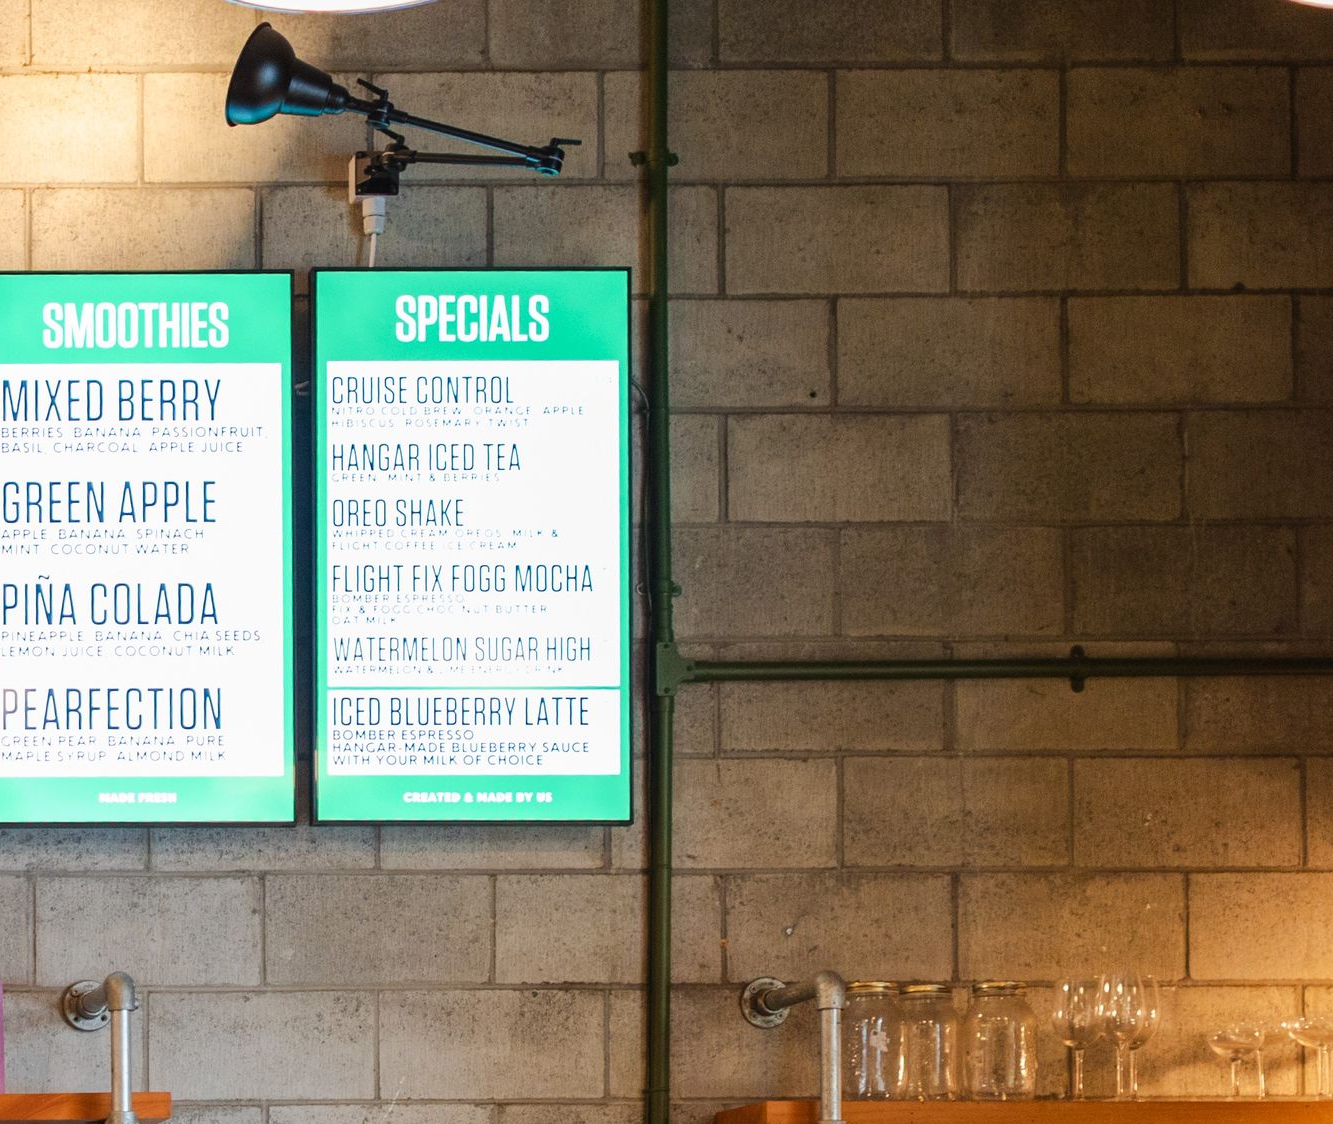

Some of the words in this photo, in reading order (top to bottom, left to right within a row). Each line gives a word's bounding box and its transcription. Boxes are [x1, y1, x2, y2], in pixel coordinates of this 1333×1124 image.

[42, 301, 230, 349] SMOOTHIES
[395, 294, 550, 343] SPECIALS
[2, 378, 104, 422] MIXED
[118, 378, 222, 422] BERRY
[332, 376, 408, 405] CRUISE
[416, 375, 514, 405] CONTROL
[332, 443, 420, 472] HANGAR
[428, 443, 475, 472] ICED
[482, 442, 521, 471] TEA
[2, 480, 105, 524] GREEN
[118, 480, 217, 524] APPLE
[332, 498, 387, 528] OREO
[395, 498, 464, 527] SHAKE
[332, 564, 404, 593] FLIGHT
[412, 564, 443, 593] FIX
[451, 564, 506, 593] FOGG
[514, 564, 594, 593] MOCHA
[2, 574, 77, 626] PIÑA
[90, 581, 219, 626] COLADA
[333, 636, 467, 662] WATERMELON
[475, 636, 539, 662] SUGAR
[546, 636, 591, 662] HIGH
[2, 687, 223, 731] PEARFECTION
[333, 696, 381, 727] ICED
[390, 696, 516, 727] BLUEBERRY
[524, 696, 590, 726] LATTE
[332, 729, 396, 741] BOMBER
[401, 728, 475, 741] ESPRESSO
[332, 741, 446, 754] HANGAR-MADE
[451, 741, 537, 754] BLUEBERRY
[542, 741, 590, 753] SAUCE
[332, 754, 371, 766] WITH
[375, 754, 418, 766] YOUR
[423, 754, 458, 766] MILK
[462, 754, 482, 766] OF
[487, 754, 543, 766] CHOICE
[403, 791, 462, 803] CREATED
[476, 791, 513, 803] MADE
[515, 792, 533, 803] BY
[536, 791, 553, 803] US
